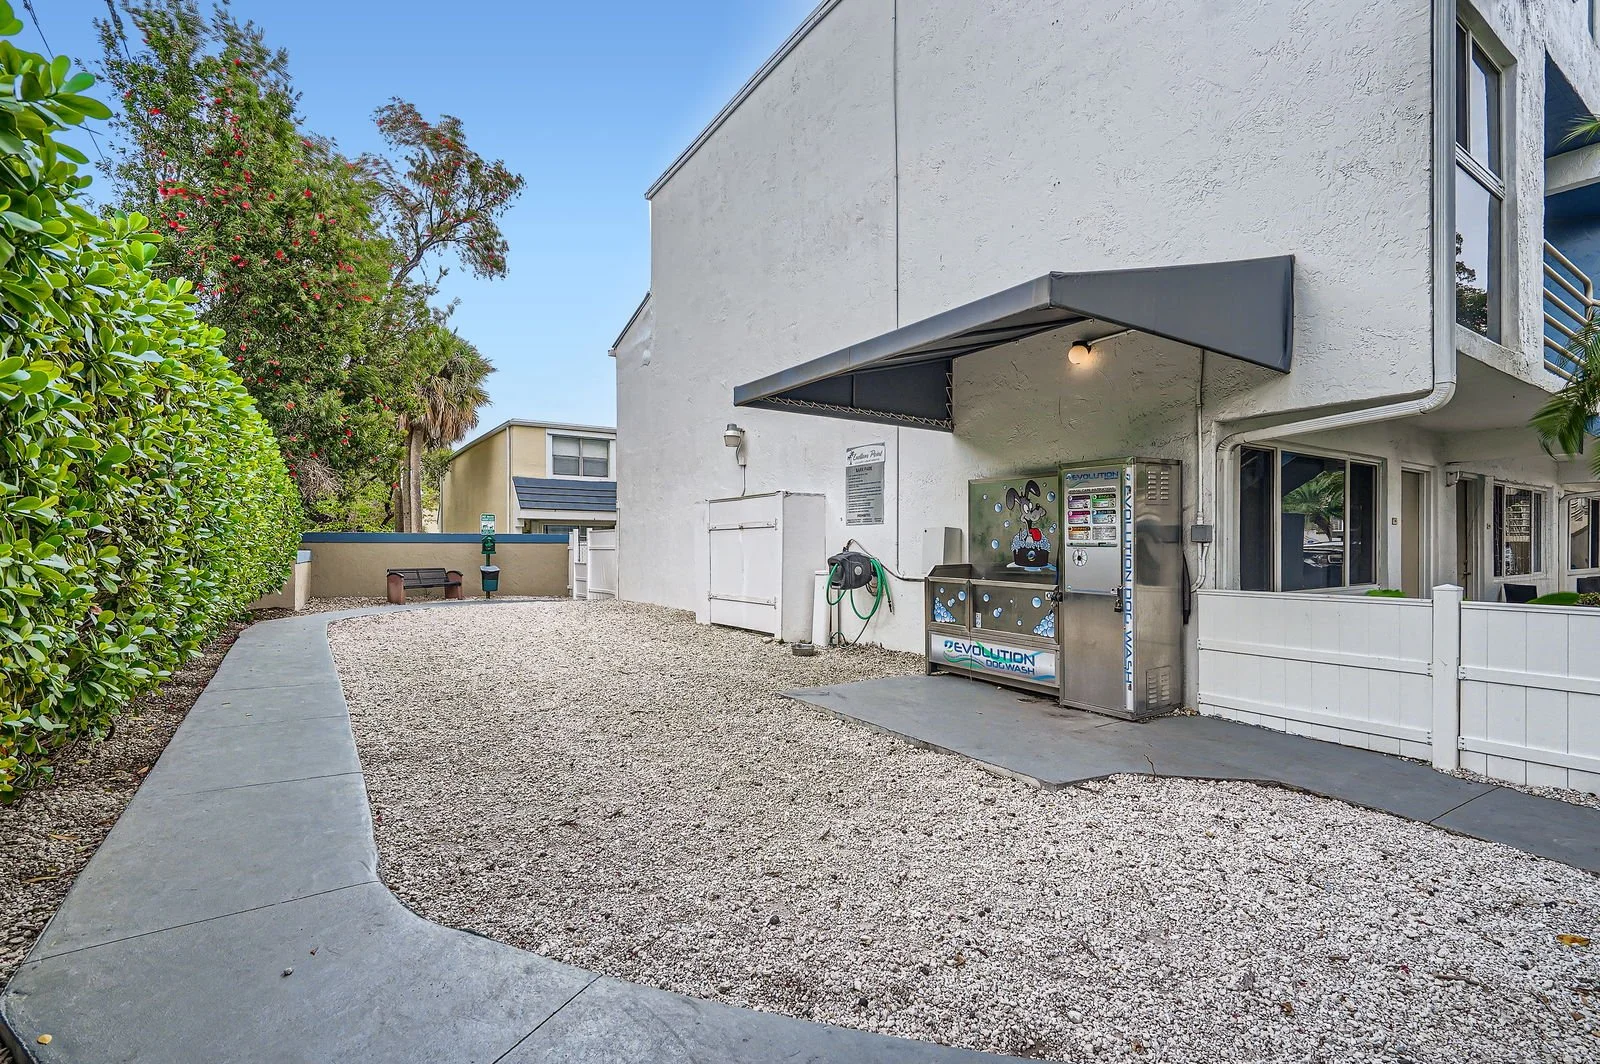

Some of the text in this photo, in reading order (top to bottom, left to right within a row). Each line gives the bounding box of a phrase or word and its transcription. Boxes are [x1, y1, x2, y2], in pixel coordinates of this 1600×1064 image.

[1072, 471, 1118, 480] EVOLUTION
[1124, 485, 1132, 683] EVOLUTION DOG WASH
[953, 642, 1035, 666] EVOLUTION
[986, 659, 1035, 676] DOG WASH
